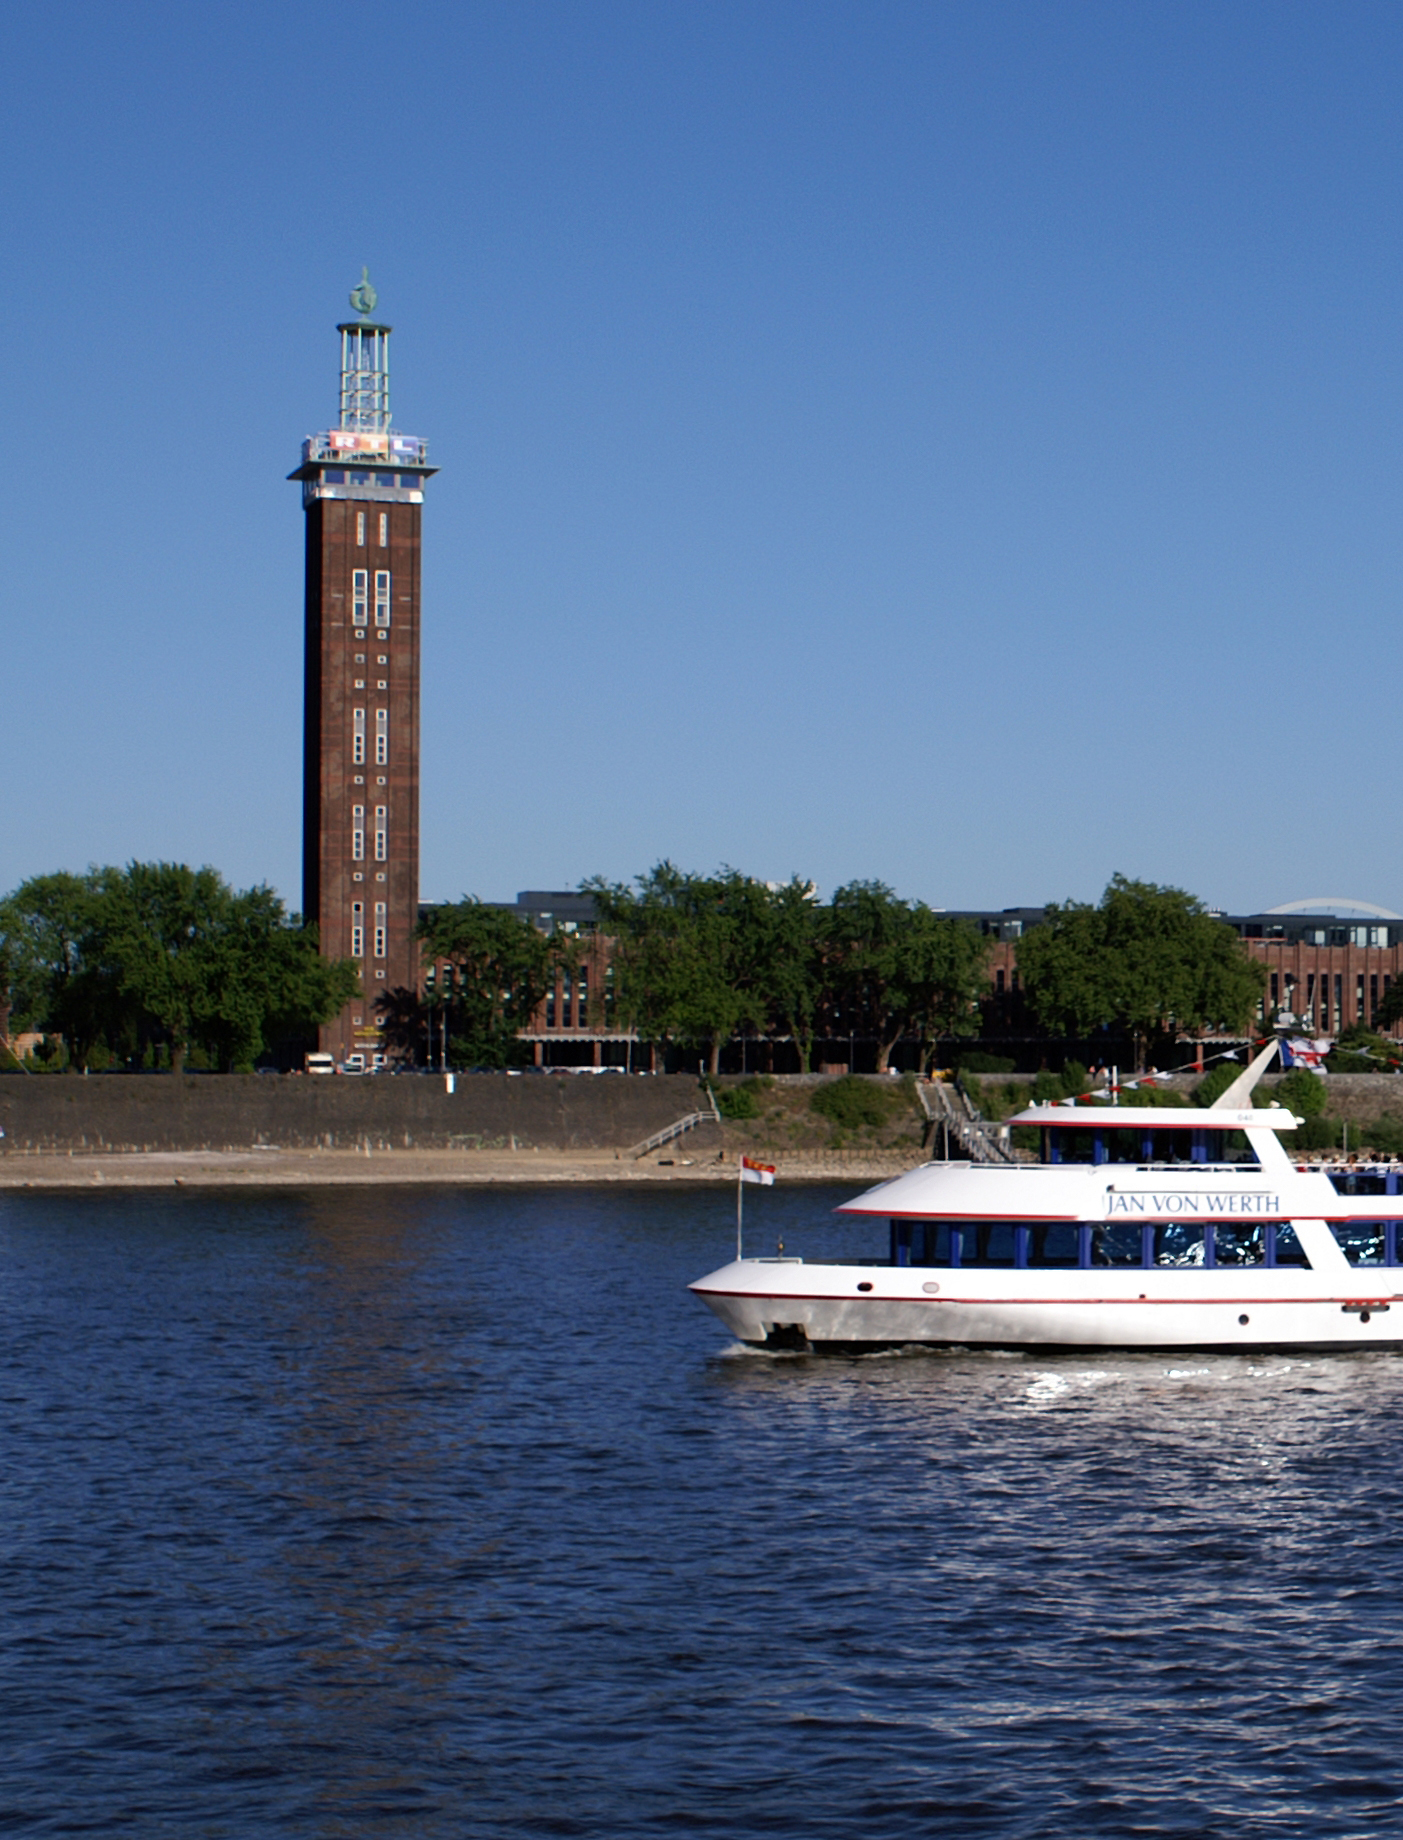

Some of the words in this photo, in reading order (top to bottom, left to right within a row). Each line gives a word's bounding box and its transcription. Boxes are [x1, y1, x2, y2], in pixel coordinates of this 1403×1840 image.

[335, 436, 413, 451] RTL
[1108, 1195, 1145, 1215] JAN
[1152, 1195, 1199, 1212] VON
[1206, 1195, 1280, 1212] WERTH
